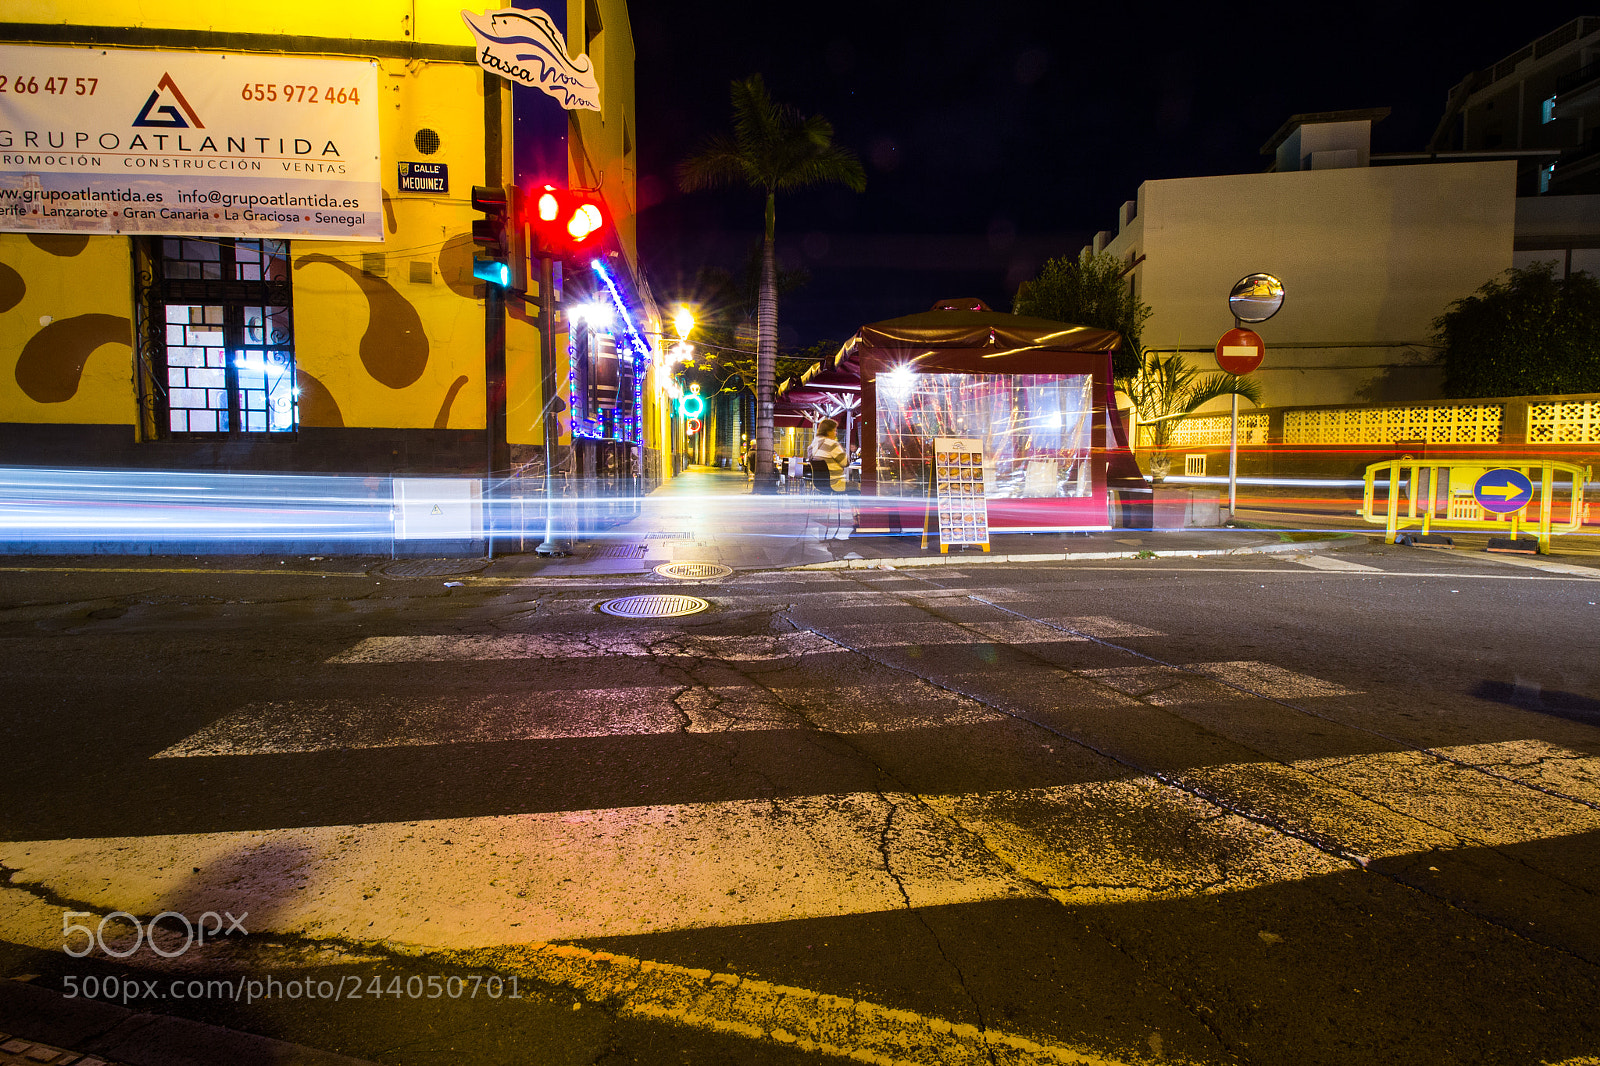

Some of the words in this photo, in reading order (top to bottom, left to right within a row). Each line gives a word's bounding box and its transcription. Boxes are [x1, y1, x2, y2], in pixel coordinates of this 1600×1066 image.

[481, 46, 534, 82] tasca
[14, 76, 39, 94] 66
[44, 77, 69, 95] 47
[75, 78, 99, 96] 57
[241, 84, 277, 102] 655
[283, 85, 319, 103] 972
[325, 87, 360, 105] 464
[123, 157, 262, 171] CONSTRUCCIÓN
[282, 162, 347, 174] VENTAS
[413, 164, 440, 174] CALLE
[402, 176, 444, 191] MEQUINEZ
[178, 189, 359, 208] info@grupoatlantida.es
[43, 205, 108, 218] Lanzarote
[123, 207, 156, 219] Gran
[160, 208, 209, 220] Canaria
[224, 209, 239, 221] La
[243, 210, 300, 222] Graciosa
[315, 212, 365, 227] Senegal
